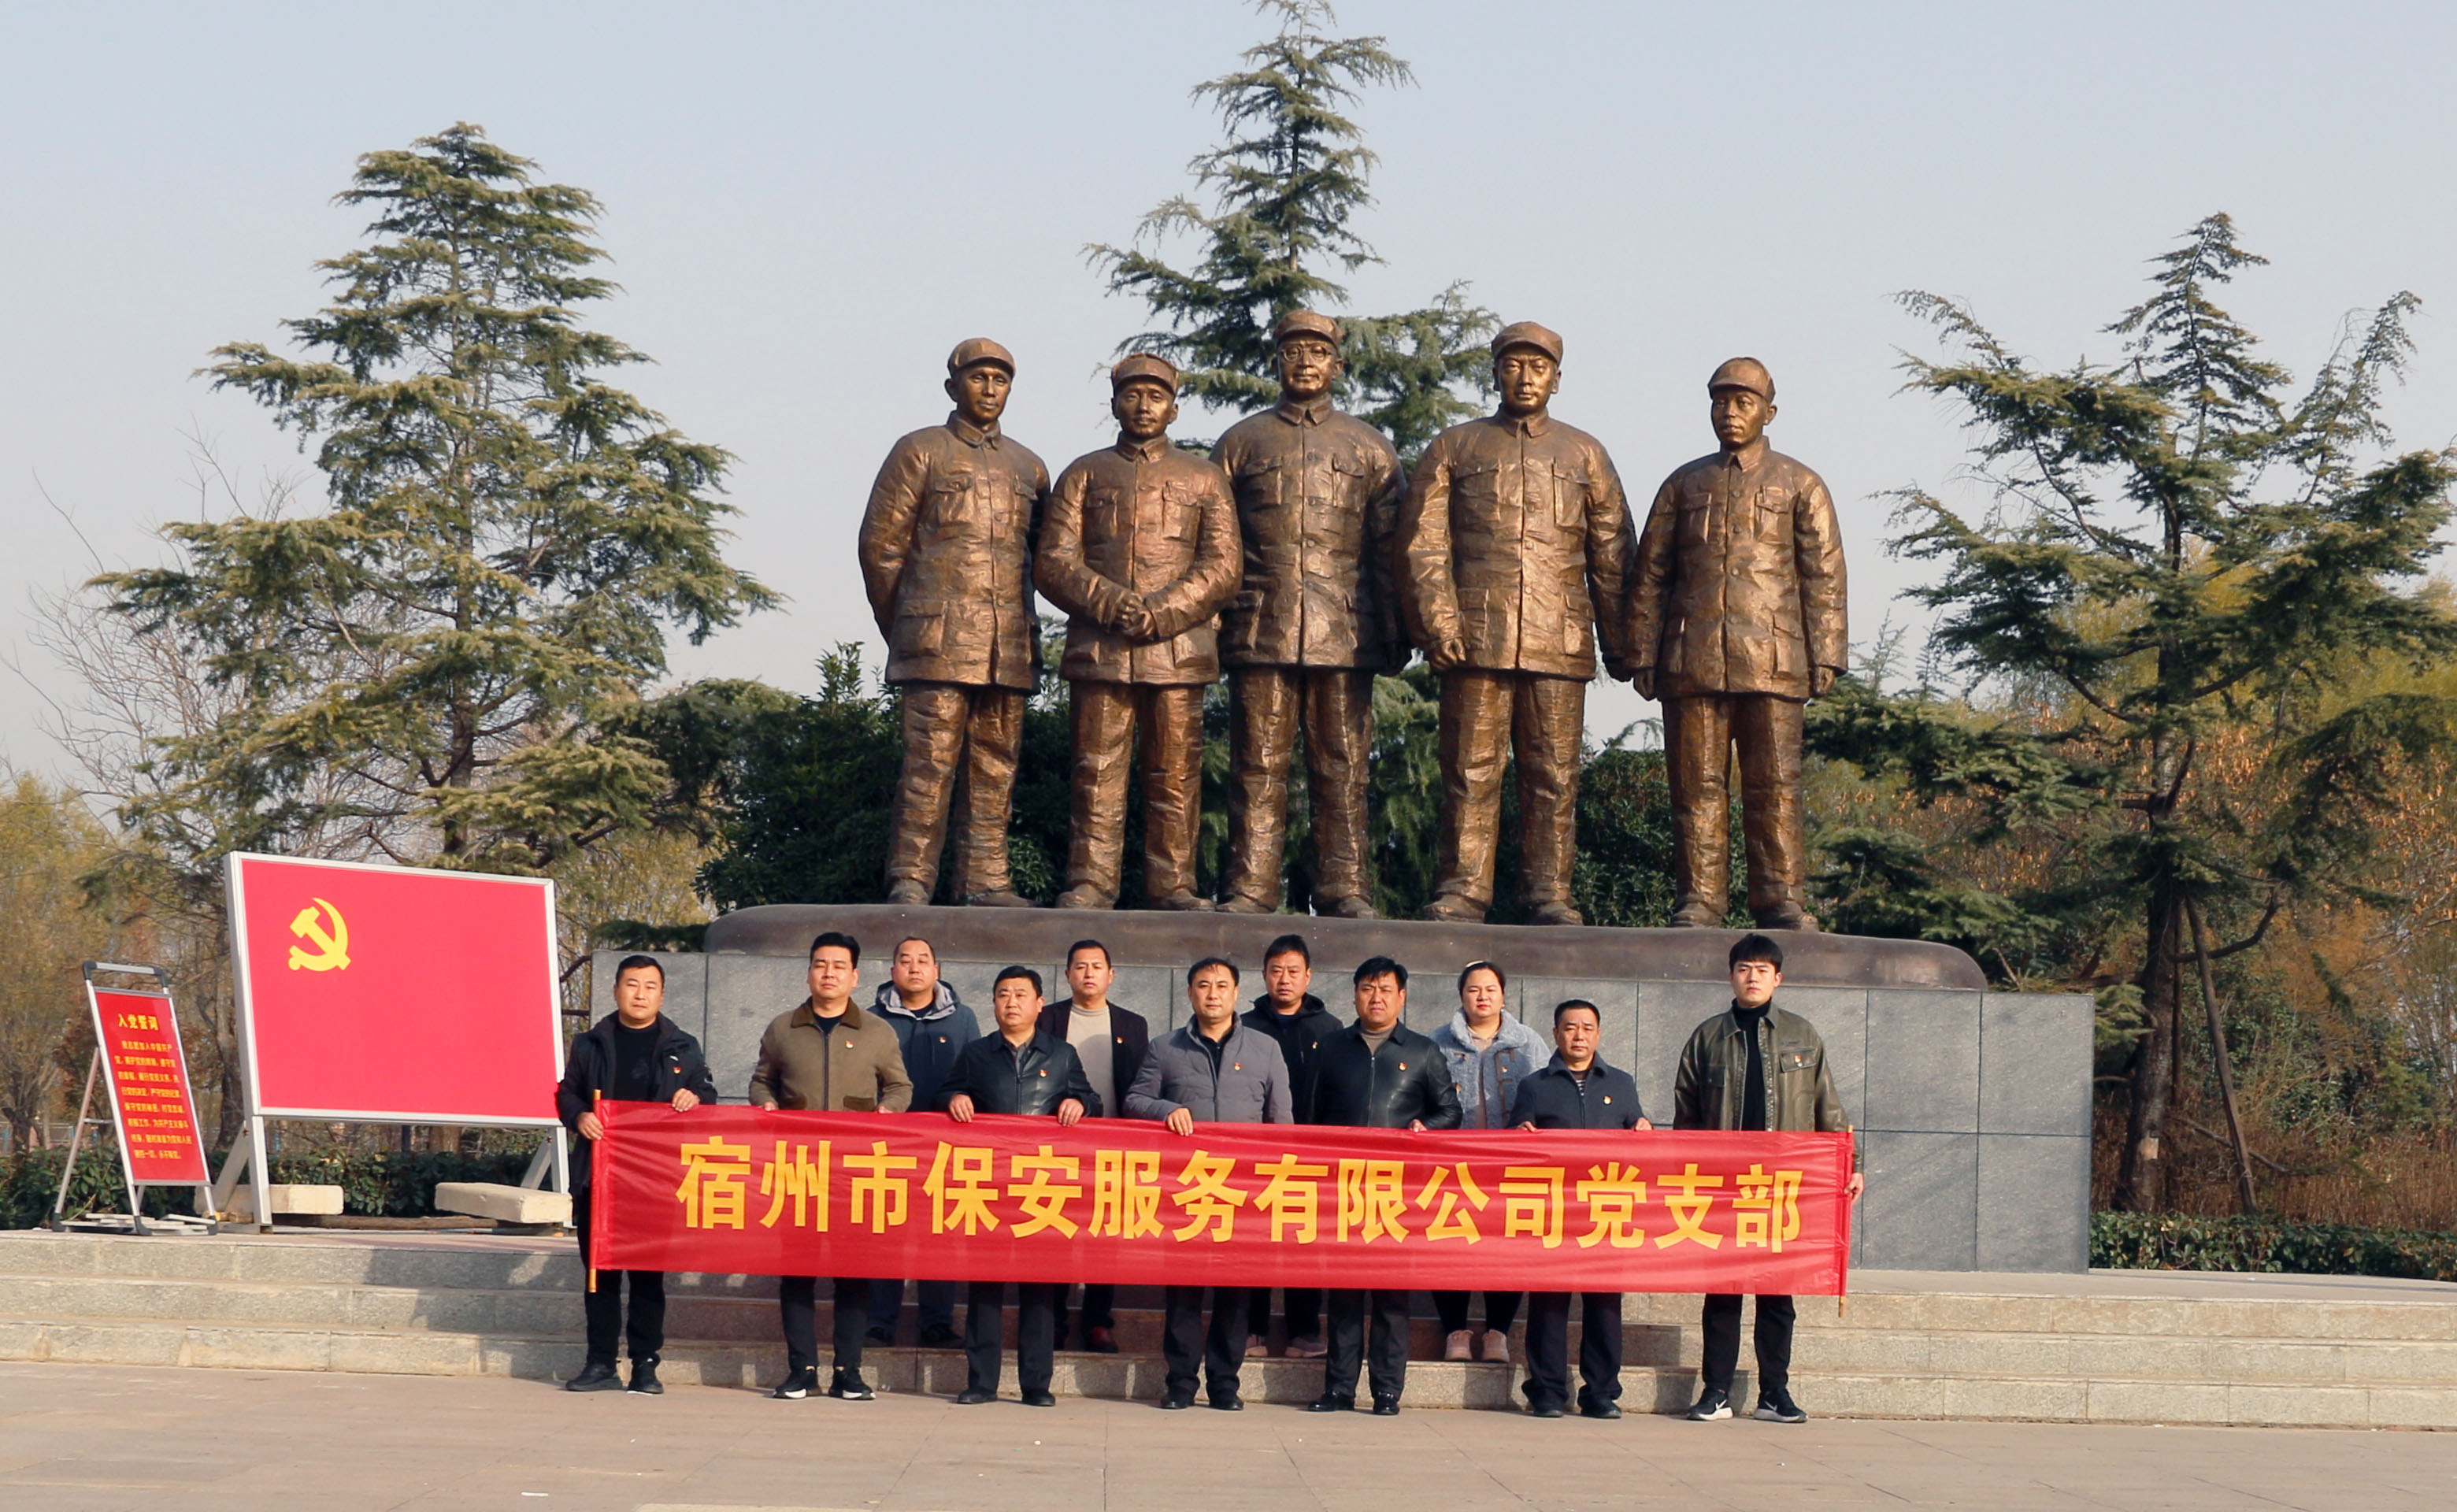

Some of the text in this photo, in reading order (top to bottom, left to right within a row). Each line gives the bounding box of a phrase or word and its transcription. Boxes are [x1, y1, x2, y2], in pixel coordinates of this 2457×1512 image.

[118, 1014, 159, 1030] 入党誓词
[676, 1136, 1803, 1256] 宿州市保安服务有限公司党支部
